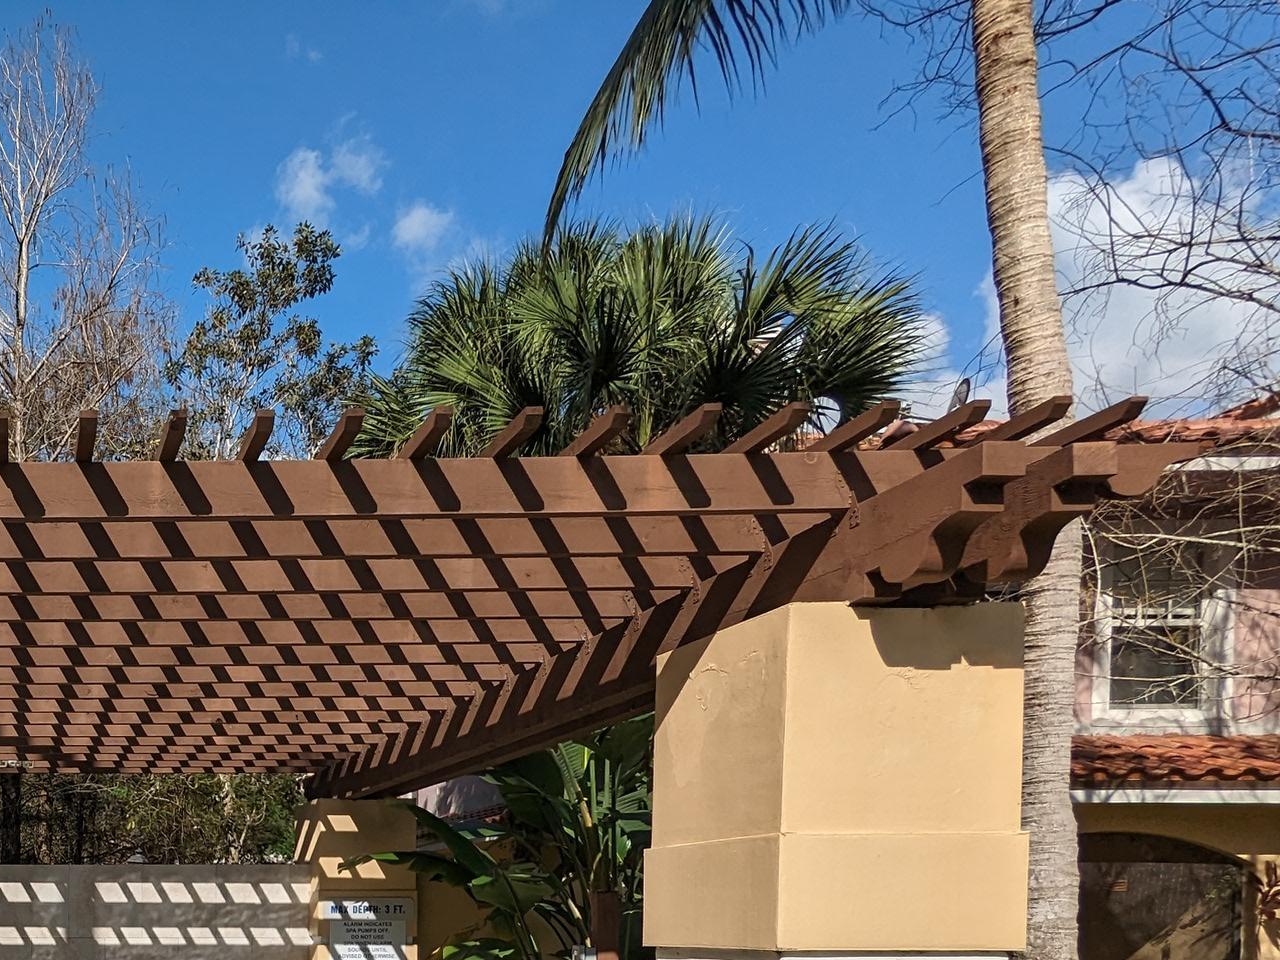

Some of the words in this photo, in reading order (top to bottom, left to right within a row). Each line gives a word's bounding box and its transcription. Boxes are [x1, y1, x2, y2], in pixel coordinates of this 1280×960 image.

[330, 905, 349, 914] MAX
[352, 905, 382, 914] DEPTH:
[384, 905, 390, 914] 3
[393, 905, 406, 914] FT.
